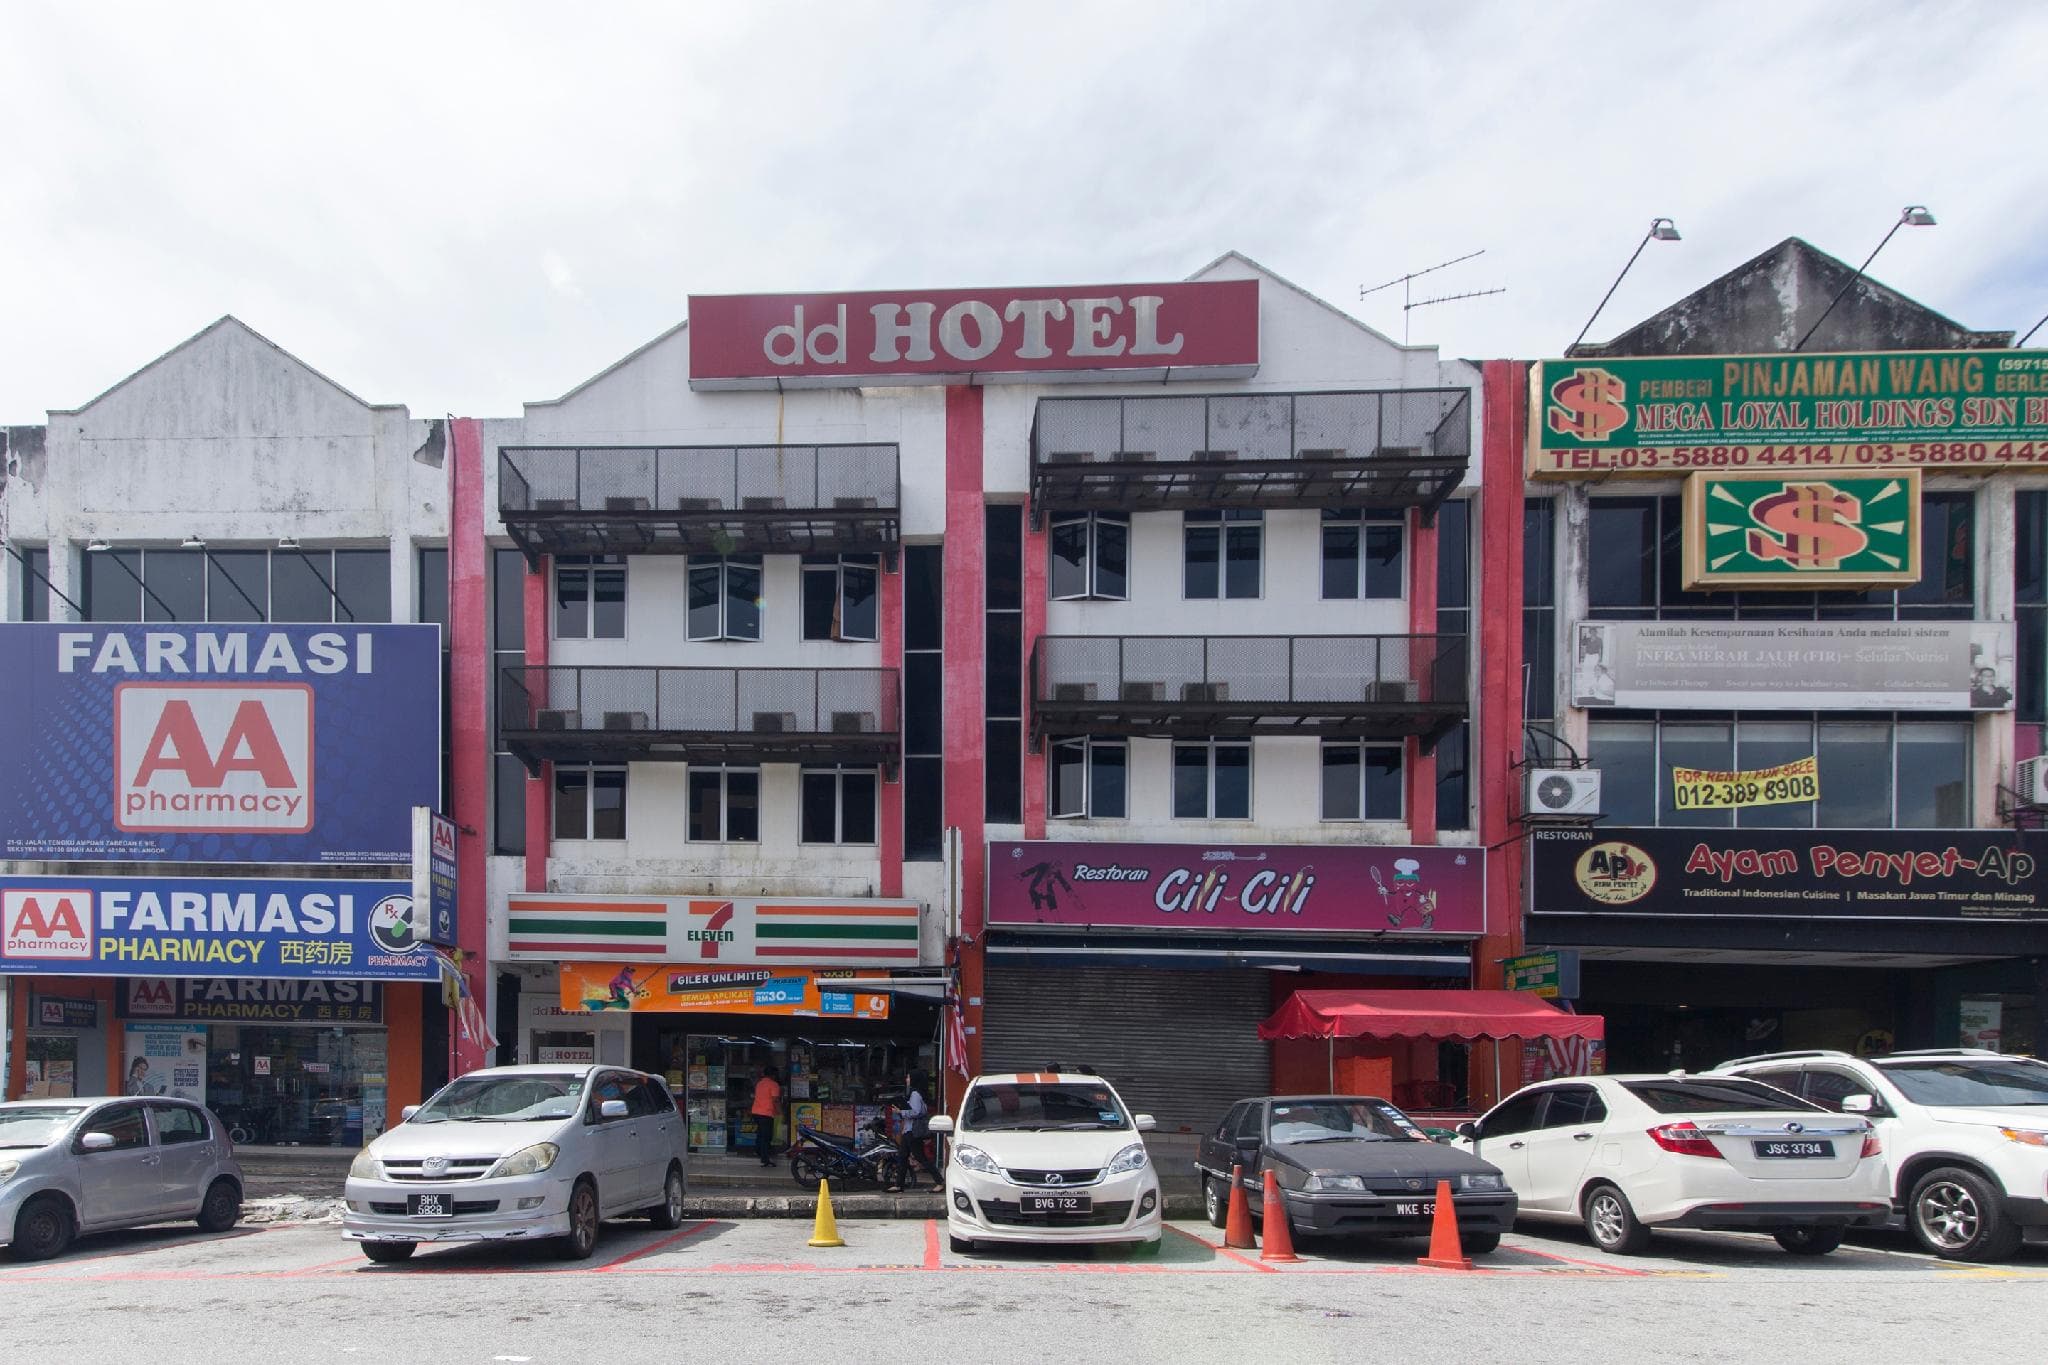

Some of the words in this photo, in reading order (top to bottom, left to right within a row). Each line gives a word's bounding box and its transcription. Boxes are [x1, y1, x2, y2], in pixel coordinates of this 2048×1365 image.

[763, 304, 847, 366] dd
[868, 296, 1184, 362] HOTEL
[1641, 379, 1713, 398] PEMBERI
[1723, 358, 1881, 397] PINJAMAN
[1889, 357, 1984, 393] WANG
[1634, 403, 1715, 432] MEGA
[1721, 401, 1808, 430] LOYAL
[1815, 398, 1955, 430] HOLDINGS
[1961, 397, 2018, 427] SDN
[1757, 446, 1833, 466] 4414
[1856, 443, 1987, 463] 03-5880
[1691, 628, 1774, 639] Kesempurnaan
[1778, 628, 1834, 637] Kesihatan
[1838, 628, 1866, 637] Anda
[1870, 628, 1912, 637] melalui
[1914, 628, 1950, 637] sistem
[58, 632, 373, 674] FARMASI
[1637, 650, 1685, 662] INFRA
[1691, 650, 1748, 662] MERAH
[1756, 650, 1799, 662] JAUH
[1905, 651, 1950, 663] Nutrisi
[133, 700, 298, 788] AA
[1675, 771, 1702, 784] FOR
[1706, 771, 1742, 783] RENT
[1782, 760, 1815, 776] SALE
[127, 790, 302, 816] pharmacy
[1677, 783, 1759, 806] 012-389
[434, 821, 453, 850] AA
[1536, 831, 1593, 840] RESTORAN
[1074, 864, 1149, 881] Restoran
[1588, 850, 1628, 880] Ap
[1685, 843, 1799, 883] Ayam
[1810, 845, 2035, 885] Penyet-Ap
[1683, 888, 1740, 897] Traditional
[1742, 889, 1800, 899] Indonesian
[1802, 890, 1840, 900] Cuisine
[1857, 891, 1906, 900] Masakan
[1908, 892, 1936, 901] Jawa
[1938, 892, 1969, 901] Timur
[1971, 892, 1992, 901] dan
[1994, 892, 2035, 903] Minang
[11, 898, 85, 938] AA
[101, 892, 354, 934] FARMASI
[8, 939, 88, 952] pharmacy
[100, 938, 265, 964] PHARMACY
[280, 940, 354, 965] 西药房
[368, 955, 429, 968] PHARMACY
[678, 975, 709, 985] GILER
[712, 971, 771, 983] UNLIMITED
[134, 978, 173, 1003] AA
[184, 978, 374, 1003] FARMASI
[681, 994, 711, 1002] SEMUA
[184, 1003, 305, 1018] PHARMACY
[555, 1051, 592, 1060] HOTEL
[1766, 1143, 1789, 1154] JSC
[1791, 1143, 1821, 1154] 3734
[421, 1195, 439, 1205] BHX
[1035, 1198, 1054, 1208] BVG
[1057, 1198, 1077, 1208] 732
[1397, 1203, 1419, 1215] WKE
